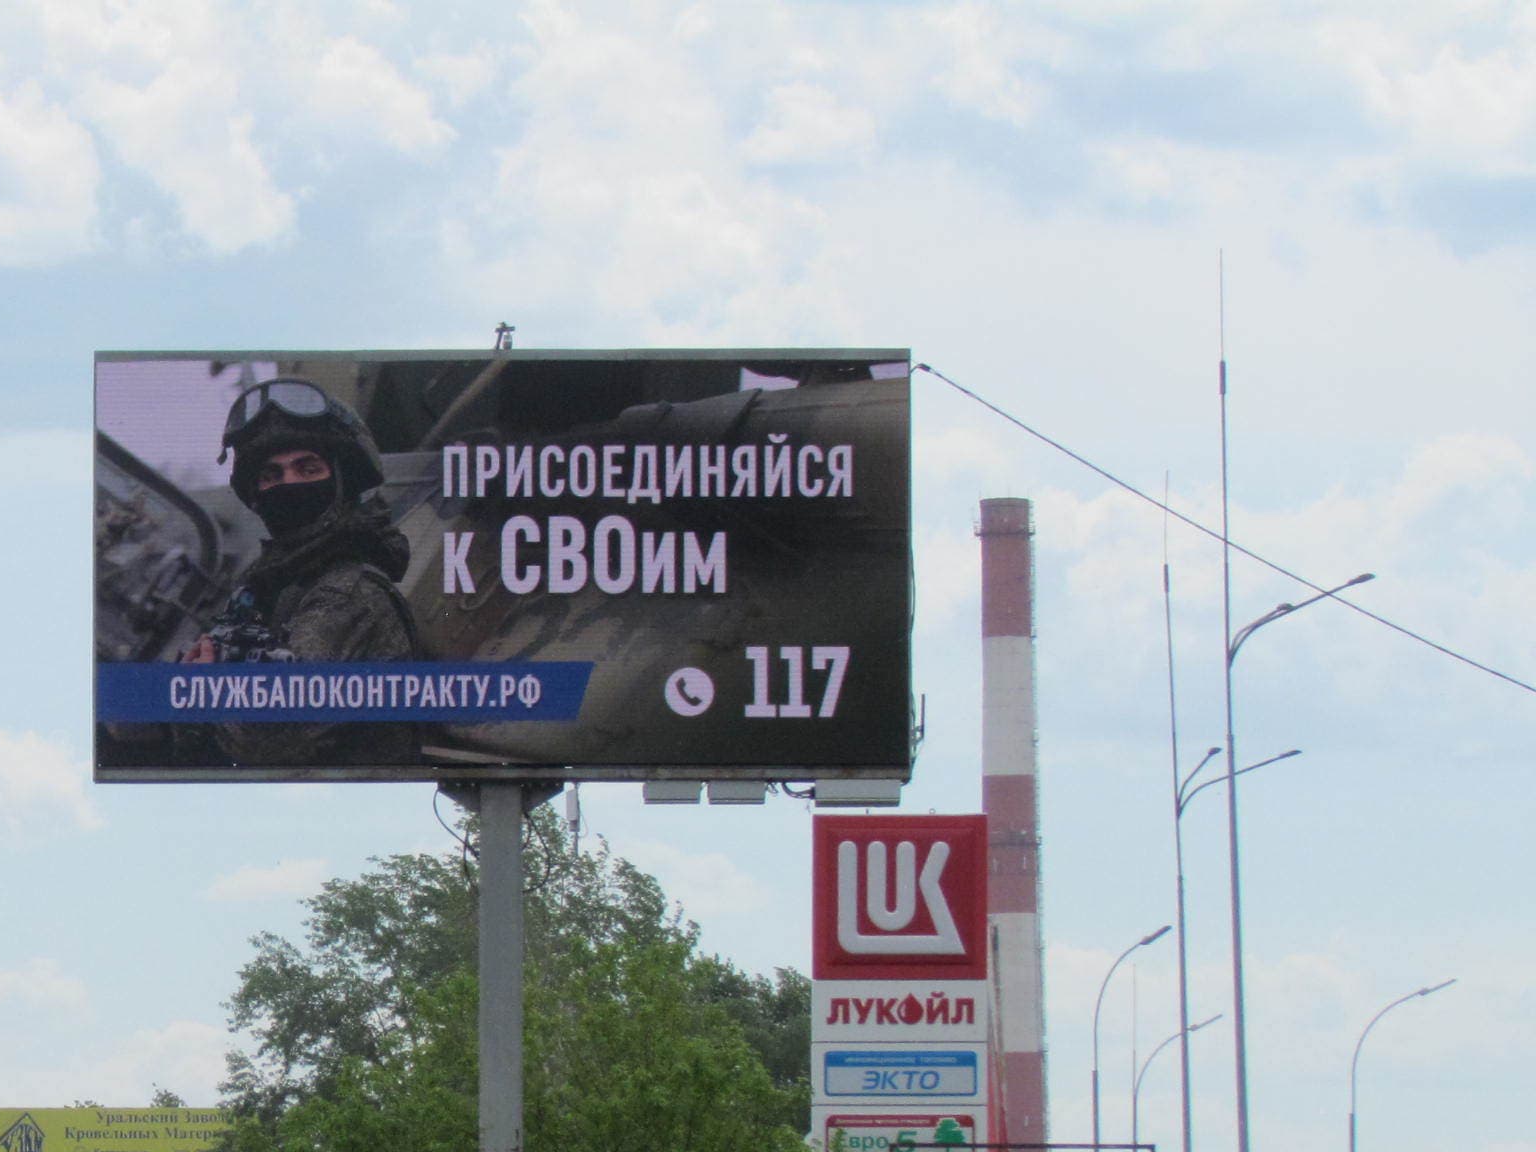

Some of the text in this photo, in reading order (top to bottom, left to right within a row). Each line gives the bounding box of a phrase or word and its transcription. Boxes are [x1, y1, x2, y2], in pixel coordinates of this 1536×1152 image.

[442, 434, 854, 505] ПРИСОЕДИНЯЙСЯ
[170, 672, 542, 711] СЛУЖБАПОКОНТРАКТУ.РФ
[744, 646, 851, 719] 117
[826, 991, 975, 1025] ЛУКОЙЛ
[862, 1070, 940, 1090] ЭКТО
[64, 1127, 158, 1142] Кровельных
[96, 1111, 178, 1126] Уральский
